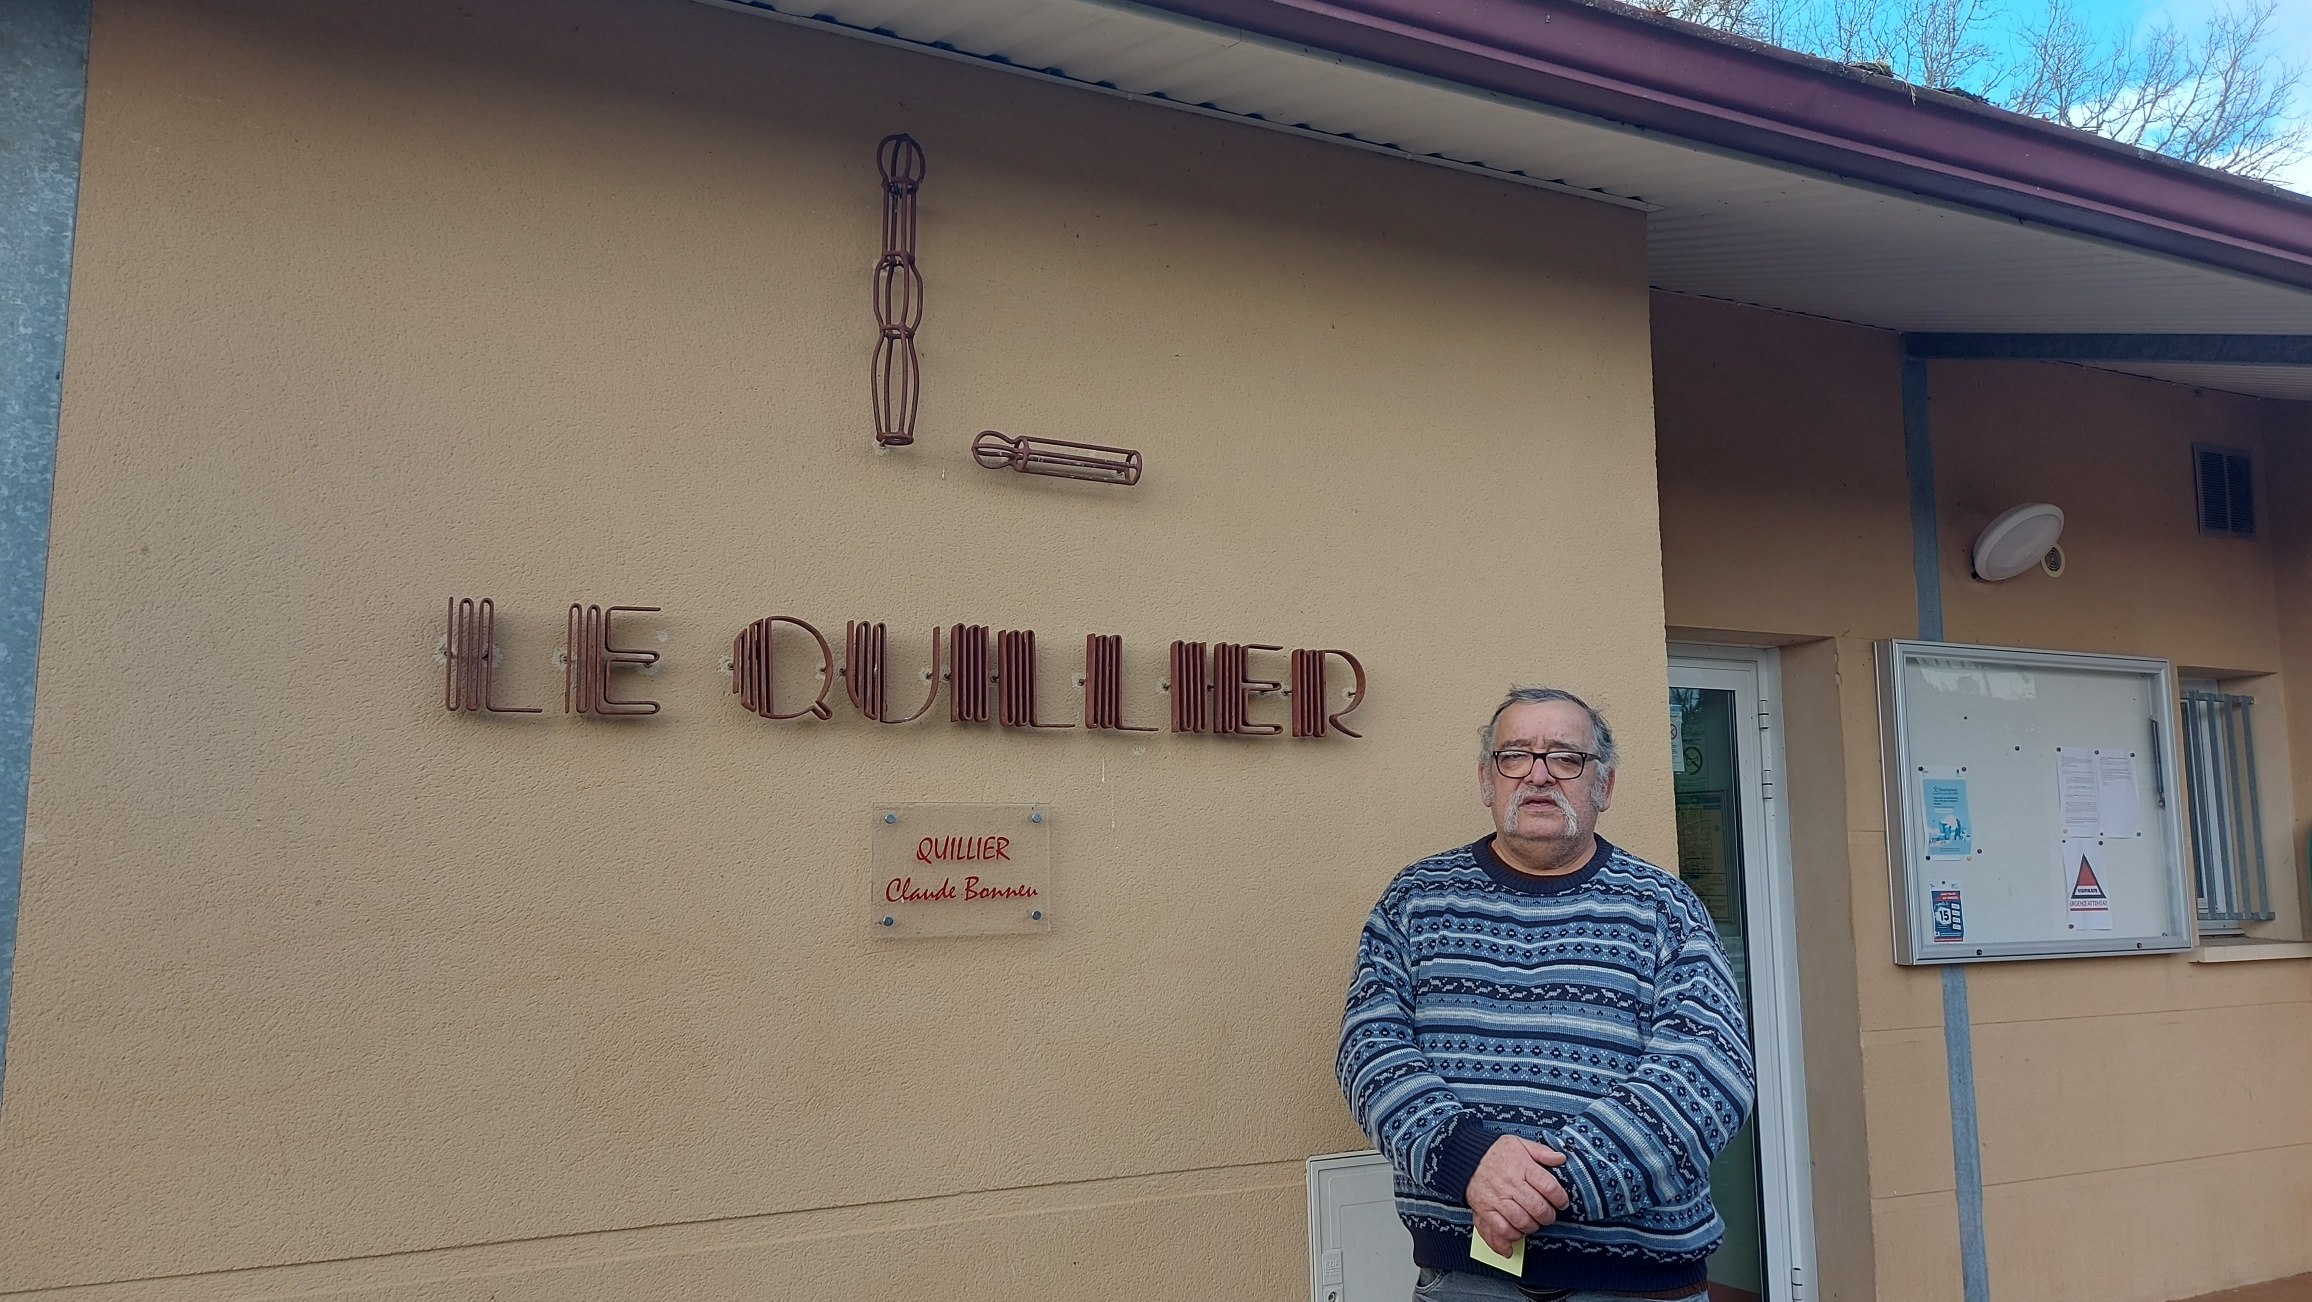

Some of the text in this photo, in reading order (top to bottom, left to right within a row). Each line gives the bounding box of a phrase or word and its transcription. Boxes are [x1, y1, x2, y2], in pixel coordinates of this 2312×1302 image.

[445, 597, 1366, 738] LE QUILLIER
[916, 836, 1011, 864] QUILLIER
[885, 877, 957, 902] Claude
[1939, 910, 1949, 921] 15
[1325, 1260, 1340, 1269] EDF
